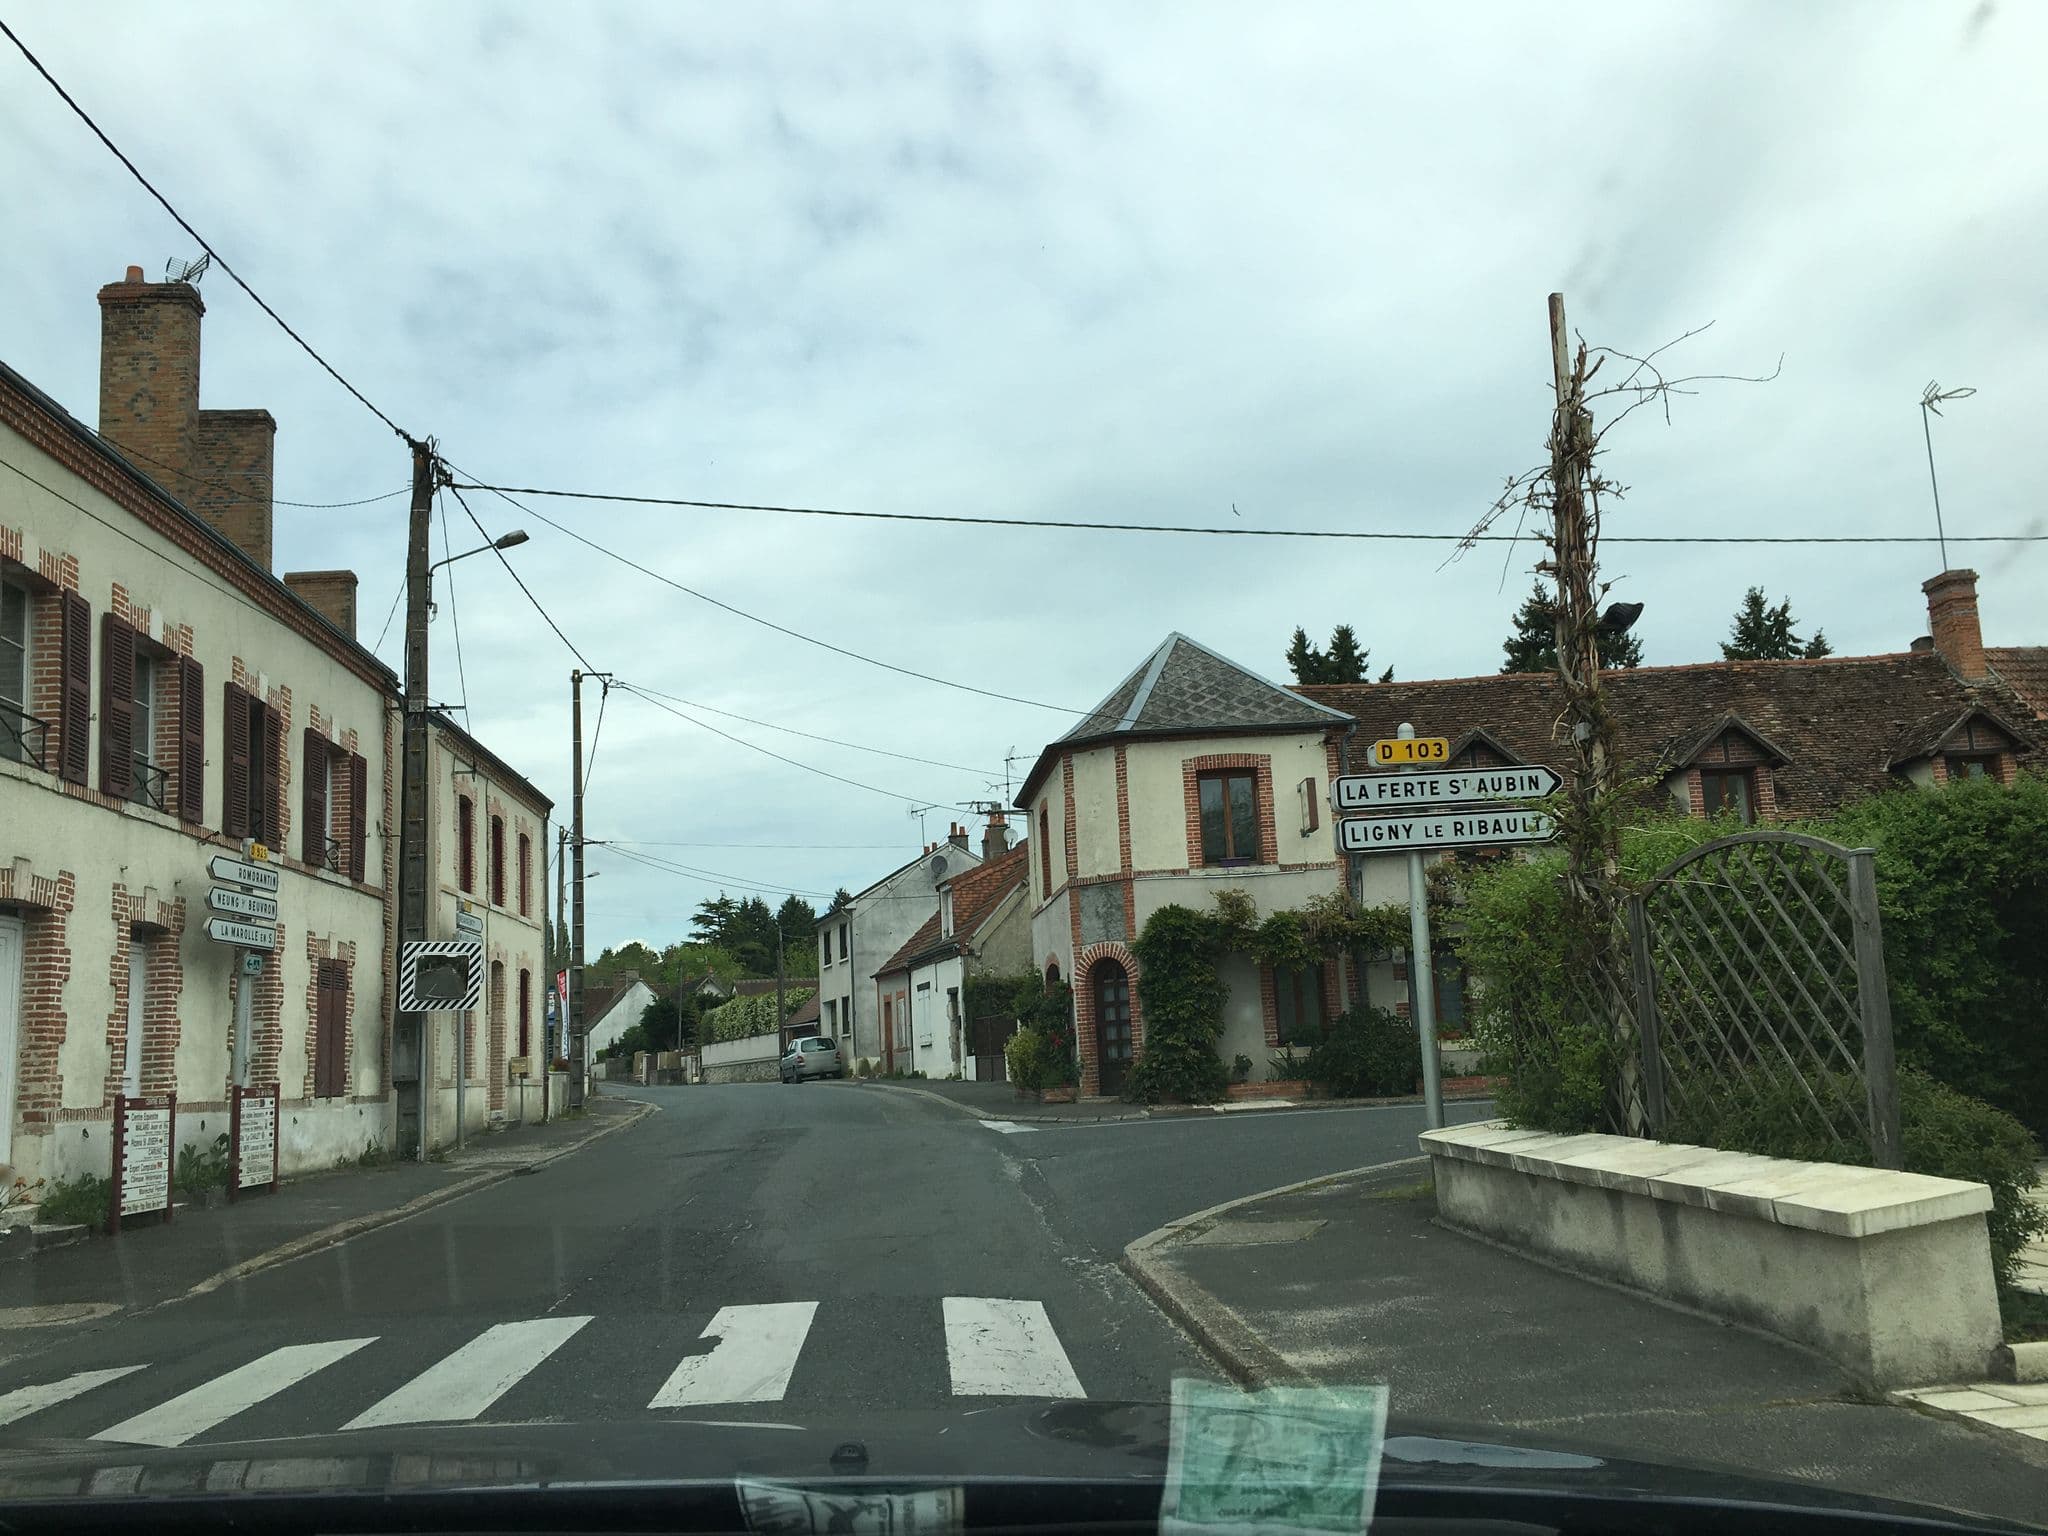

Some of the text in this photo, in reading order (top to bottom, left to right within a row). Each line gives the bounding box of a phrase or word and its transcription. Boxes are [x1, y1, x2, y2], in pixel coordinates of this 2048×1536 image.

[1381, 742, 1444, 760] D 103
[1346, 783, 1370, 801] LA
[1377, 780, 1441, 799] FERTE
[1477, 774, 1541, 794] AUBIN
[1350, 823, 1415, 843] LIGNY
[1424, 824, 1444, 839] LE
[238, 867, 276, 887] ROMORANTIN
[217, 893, 239, 909] NEUNG
[248, 900, 275, 916] BEUVRON
[221, 925, 228, 936] LA
[231, 928, 258, 942] MAROLLE
